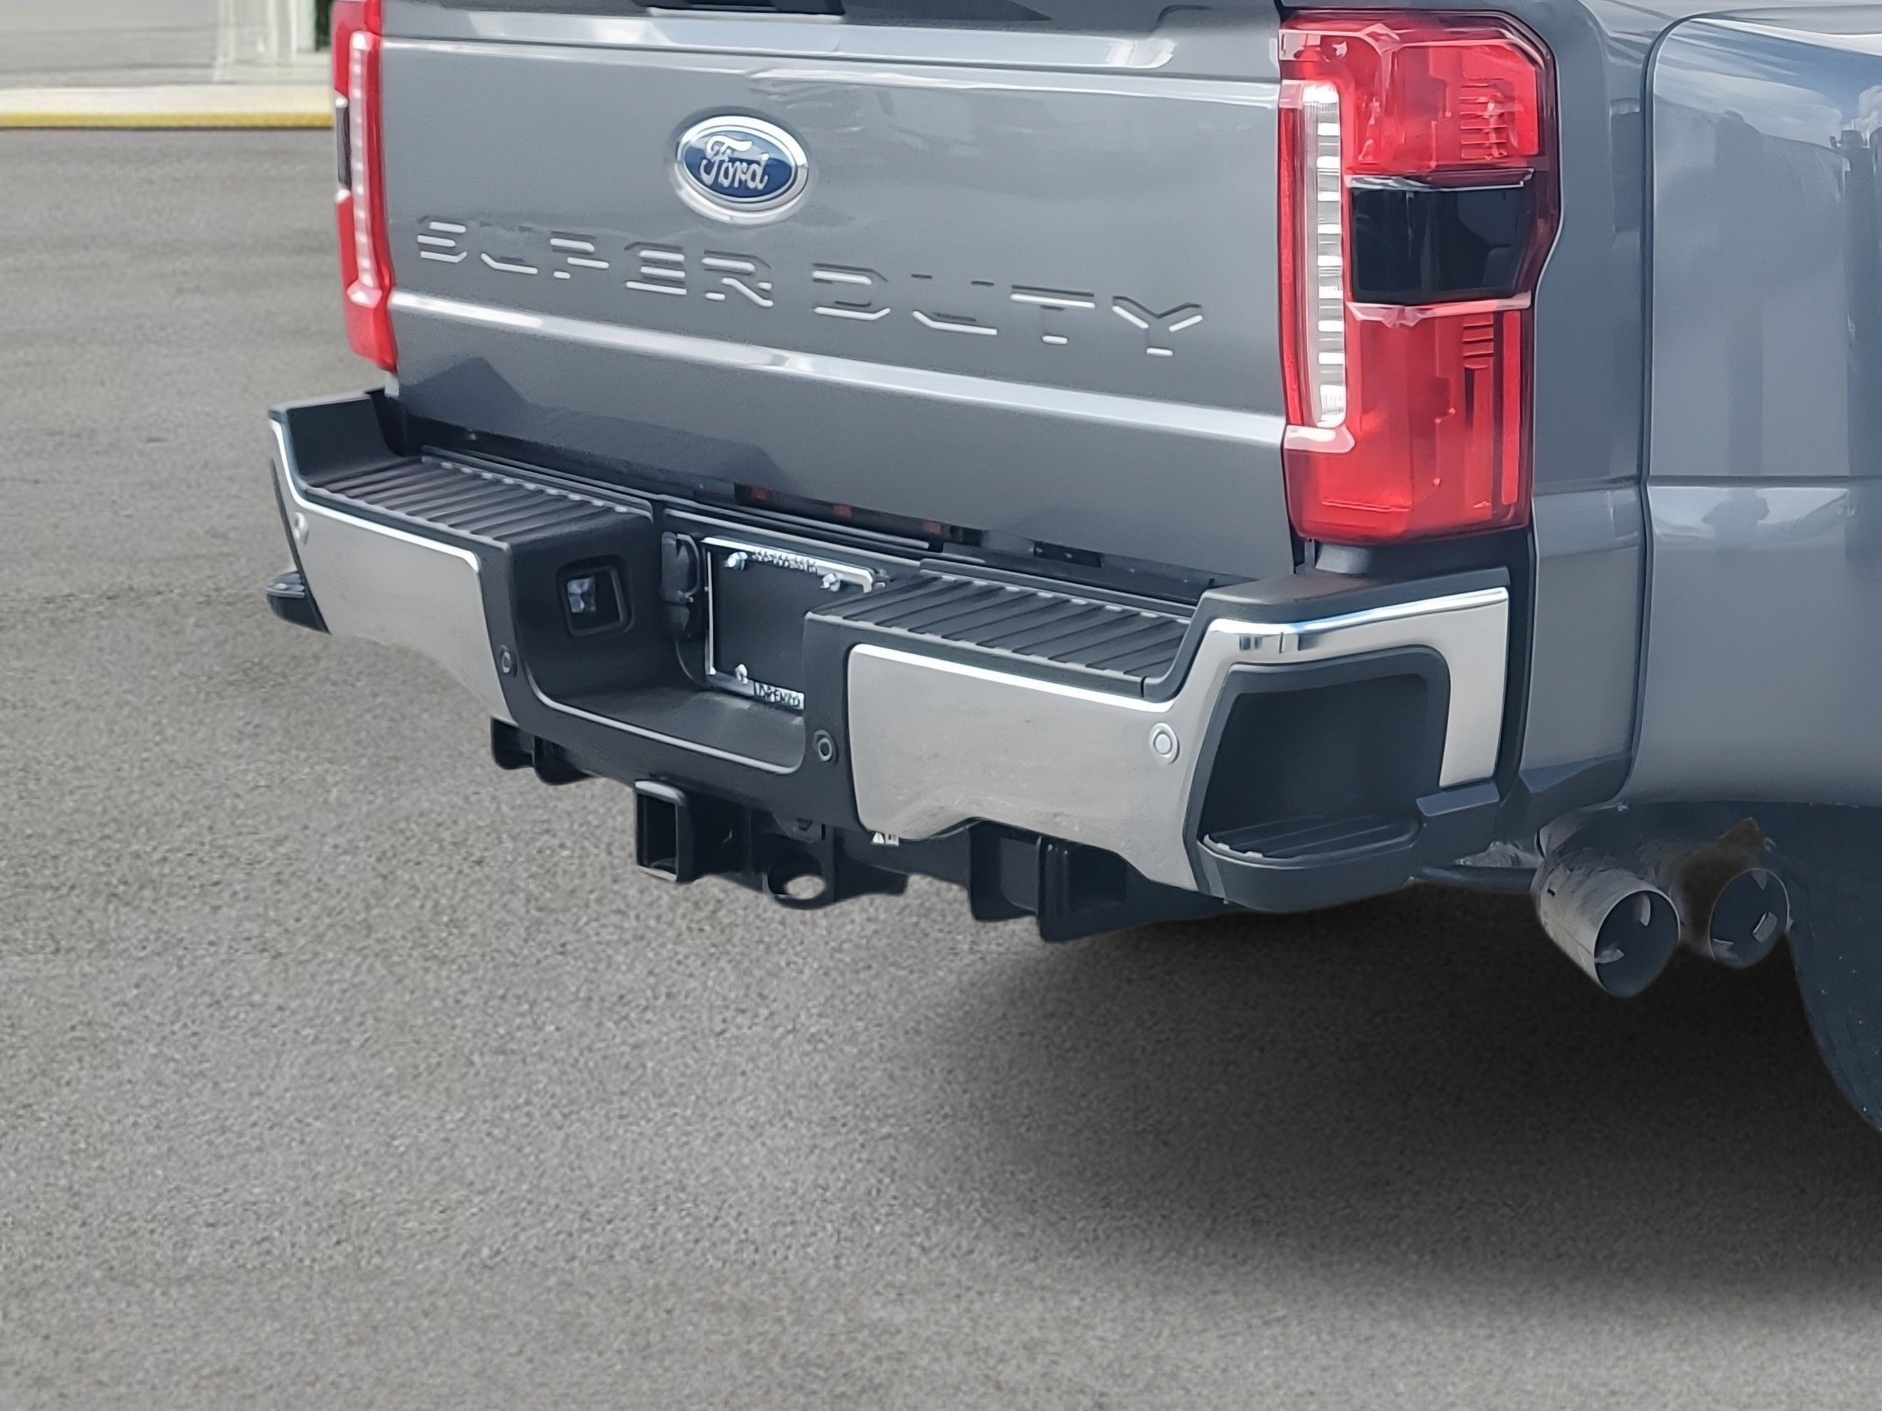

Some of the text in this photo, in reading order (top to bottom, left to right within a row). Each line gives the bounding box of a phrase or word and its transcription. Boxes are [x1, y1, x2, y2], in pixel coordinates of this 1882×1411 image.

[700, 135, 770, 190] Ford
[417, 214, 1203, 357] SUPER DUTY
